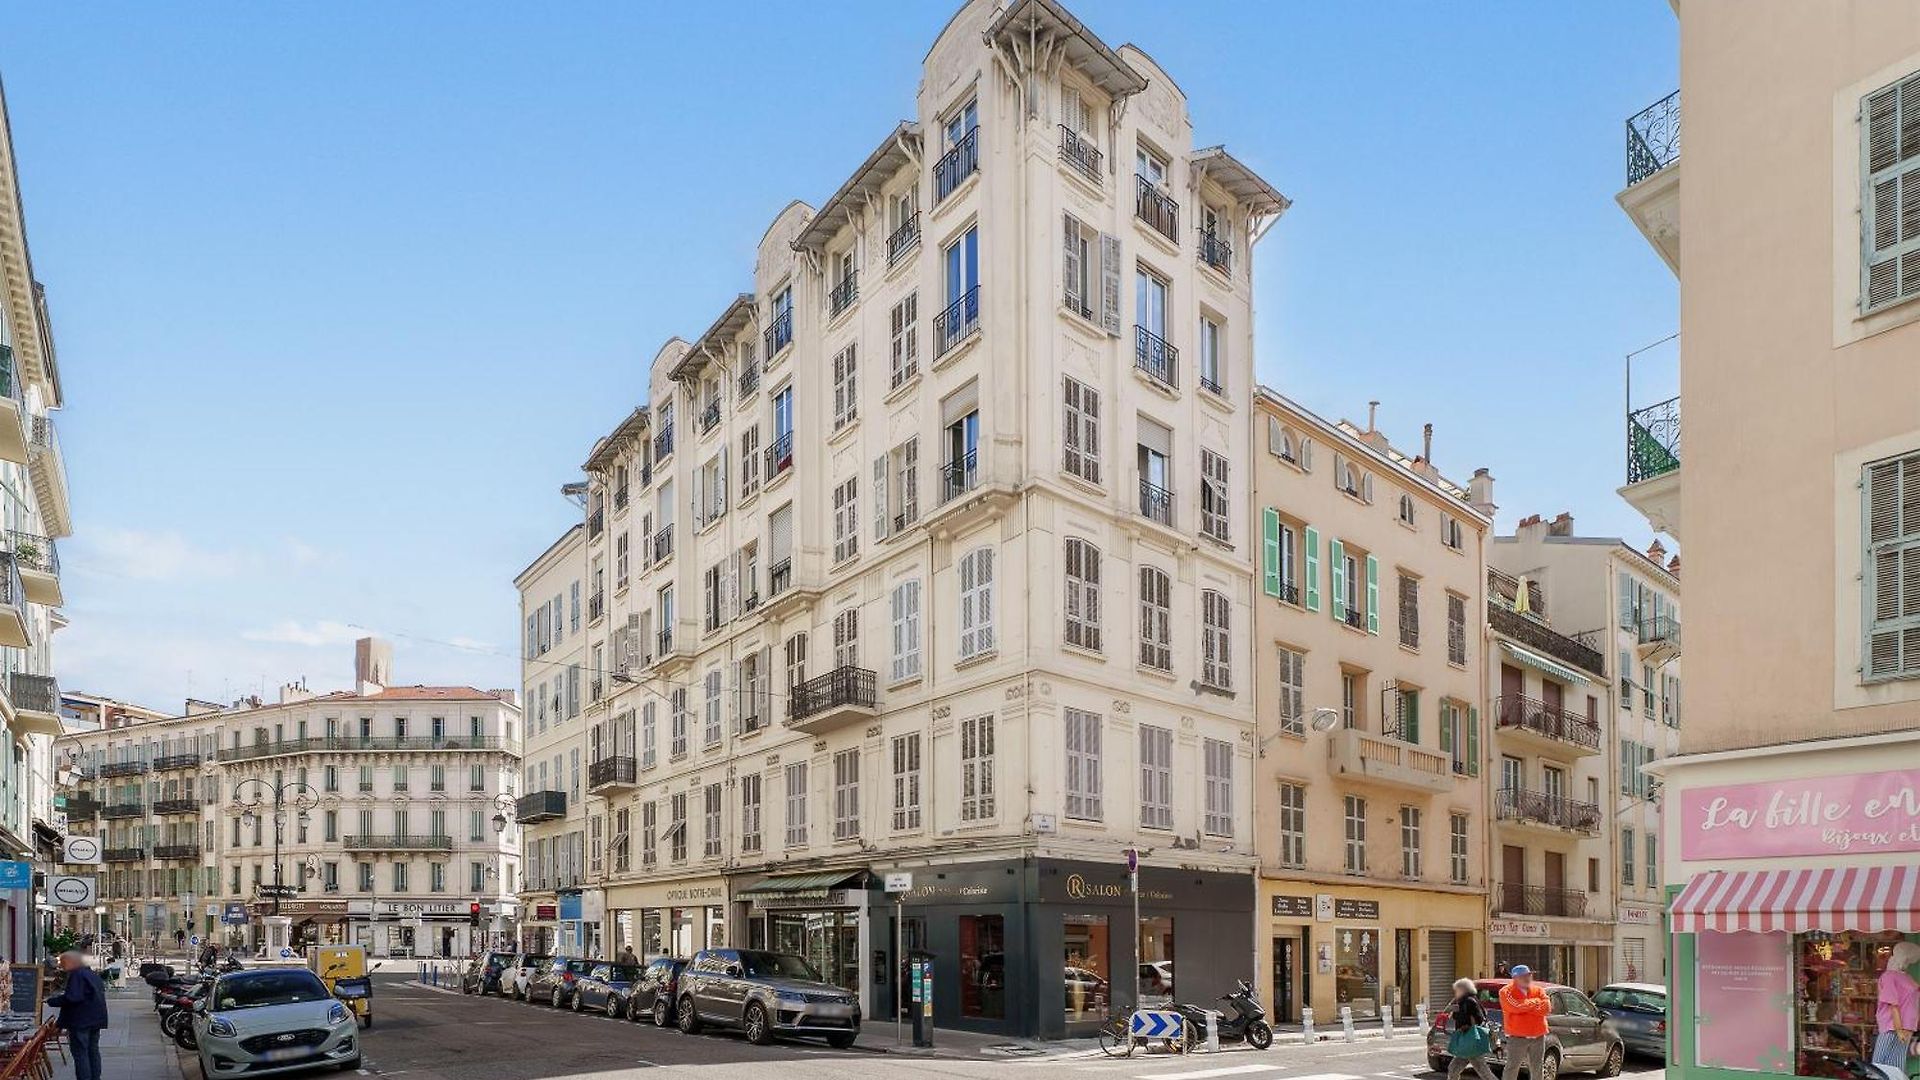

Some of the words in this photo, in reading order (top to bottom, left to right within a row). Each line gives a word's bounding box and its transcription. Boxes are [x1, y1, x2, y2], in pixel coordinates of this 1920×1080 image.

[1701, 797, 1757, 830] La
[1765, 790, 1851, 829] fille
[1822, 827, 1893, 850] Bijoux
[1086, 883, 1121, 897] SALON
[388, 903, 397, 912] LE
[403, 903, 424, 912] BON
[429, 903, 456, 912] LITIER
